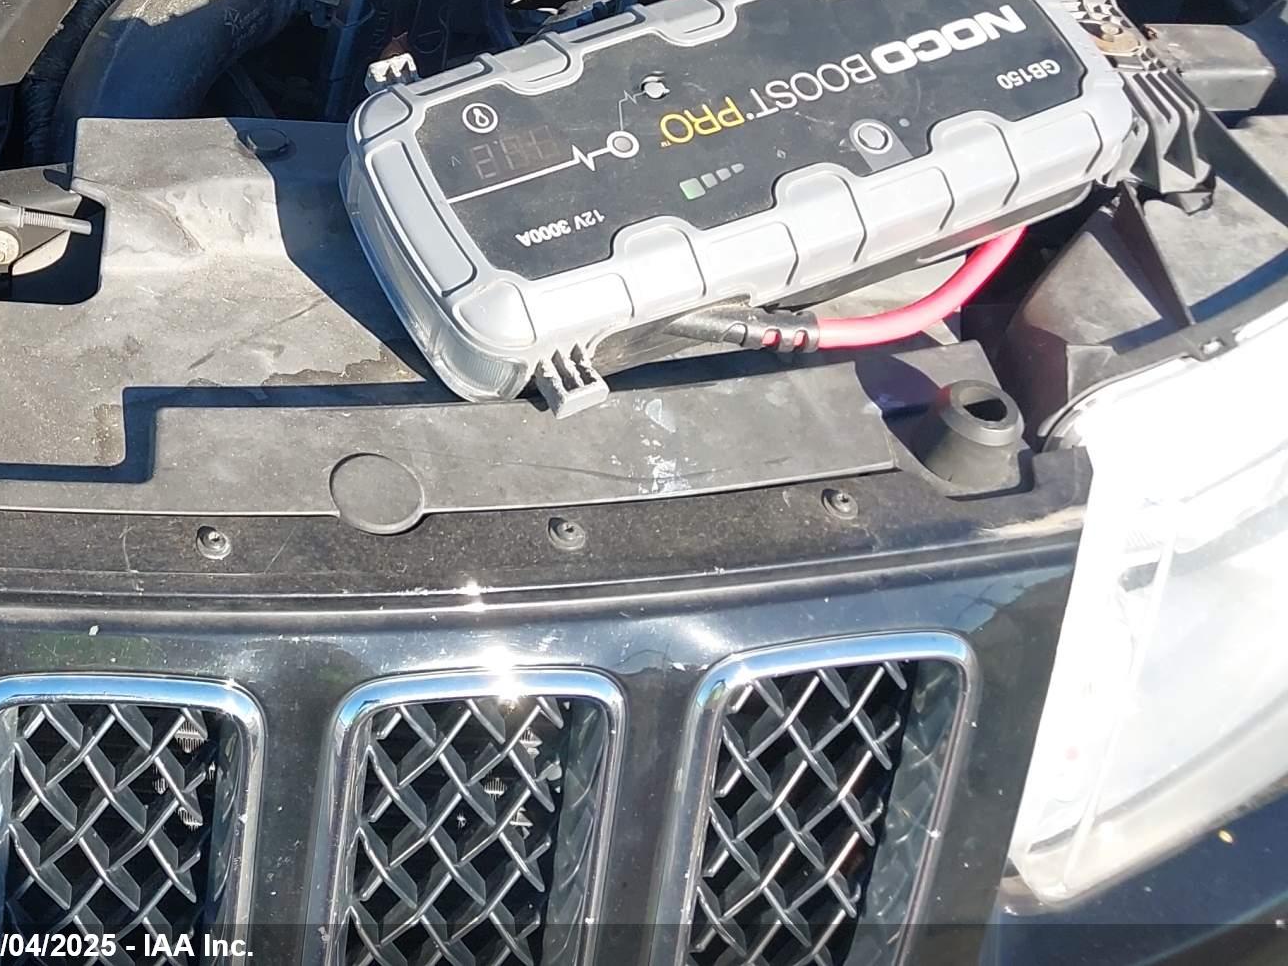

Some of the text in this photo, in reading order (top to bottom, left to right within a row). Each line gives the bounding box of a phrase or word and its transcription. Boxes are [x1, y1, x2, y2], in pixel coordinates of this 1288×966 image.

[869, 4, 1027, 75] NOCO
[996, 59, 1062, 90] GB150
[515, 208, 606, 248] 12V 3000A
